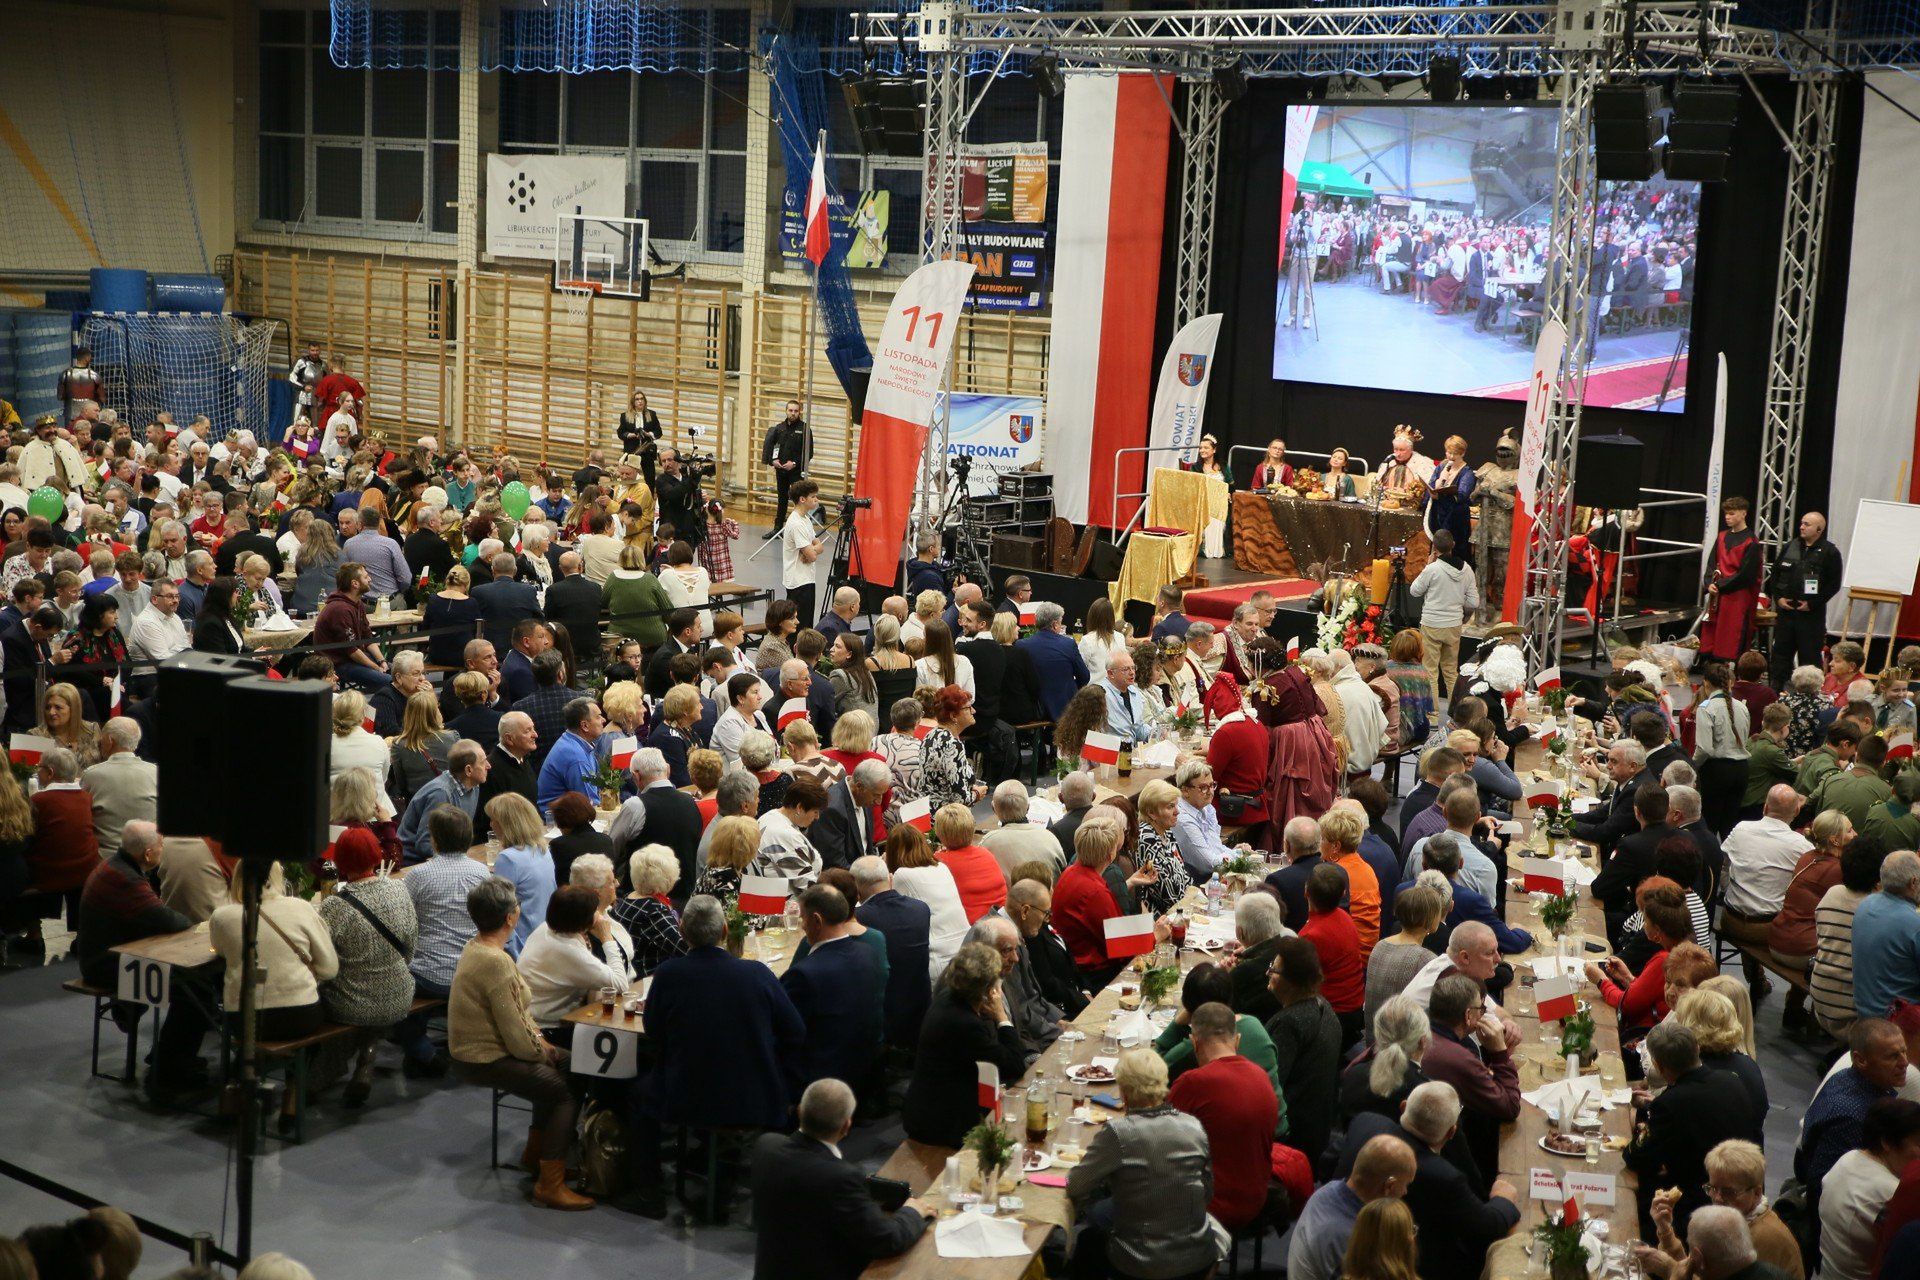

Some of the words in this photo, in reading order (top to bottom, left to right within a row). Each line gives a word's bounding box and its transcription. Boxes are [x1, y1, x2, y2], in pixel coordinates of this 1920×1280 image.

[537, 226, 570, 235] CENTM
[941, 234, 983, 247] ATRIAŁY
[984, 235, 1045, 249] BUDOWLANE
[1012, 260, 1035, 269] GHB
[902, 305, 944, 349] 11
[884, 348, 938, 371] LISTOPADA
[889, 364, 928, 380] NARODOWE
[894, 374, 918, 386] ŚWIĘTO
[124, 959, 163, 1005] 10
[593, 1029, 619, 1074] 9
